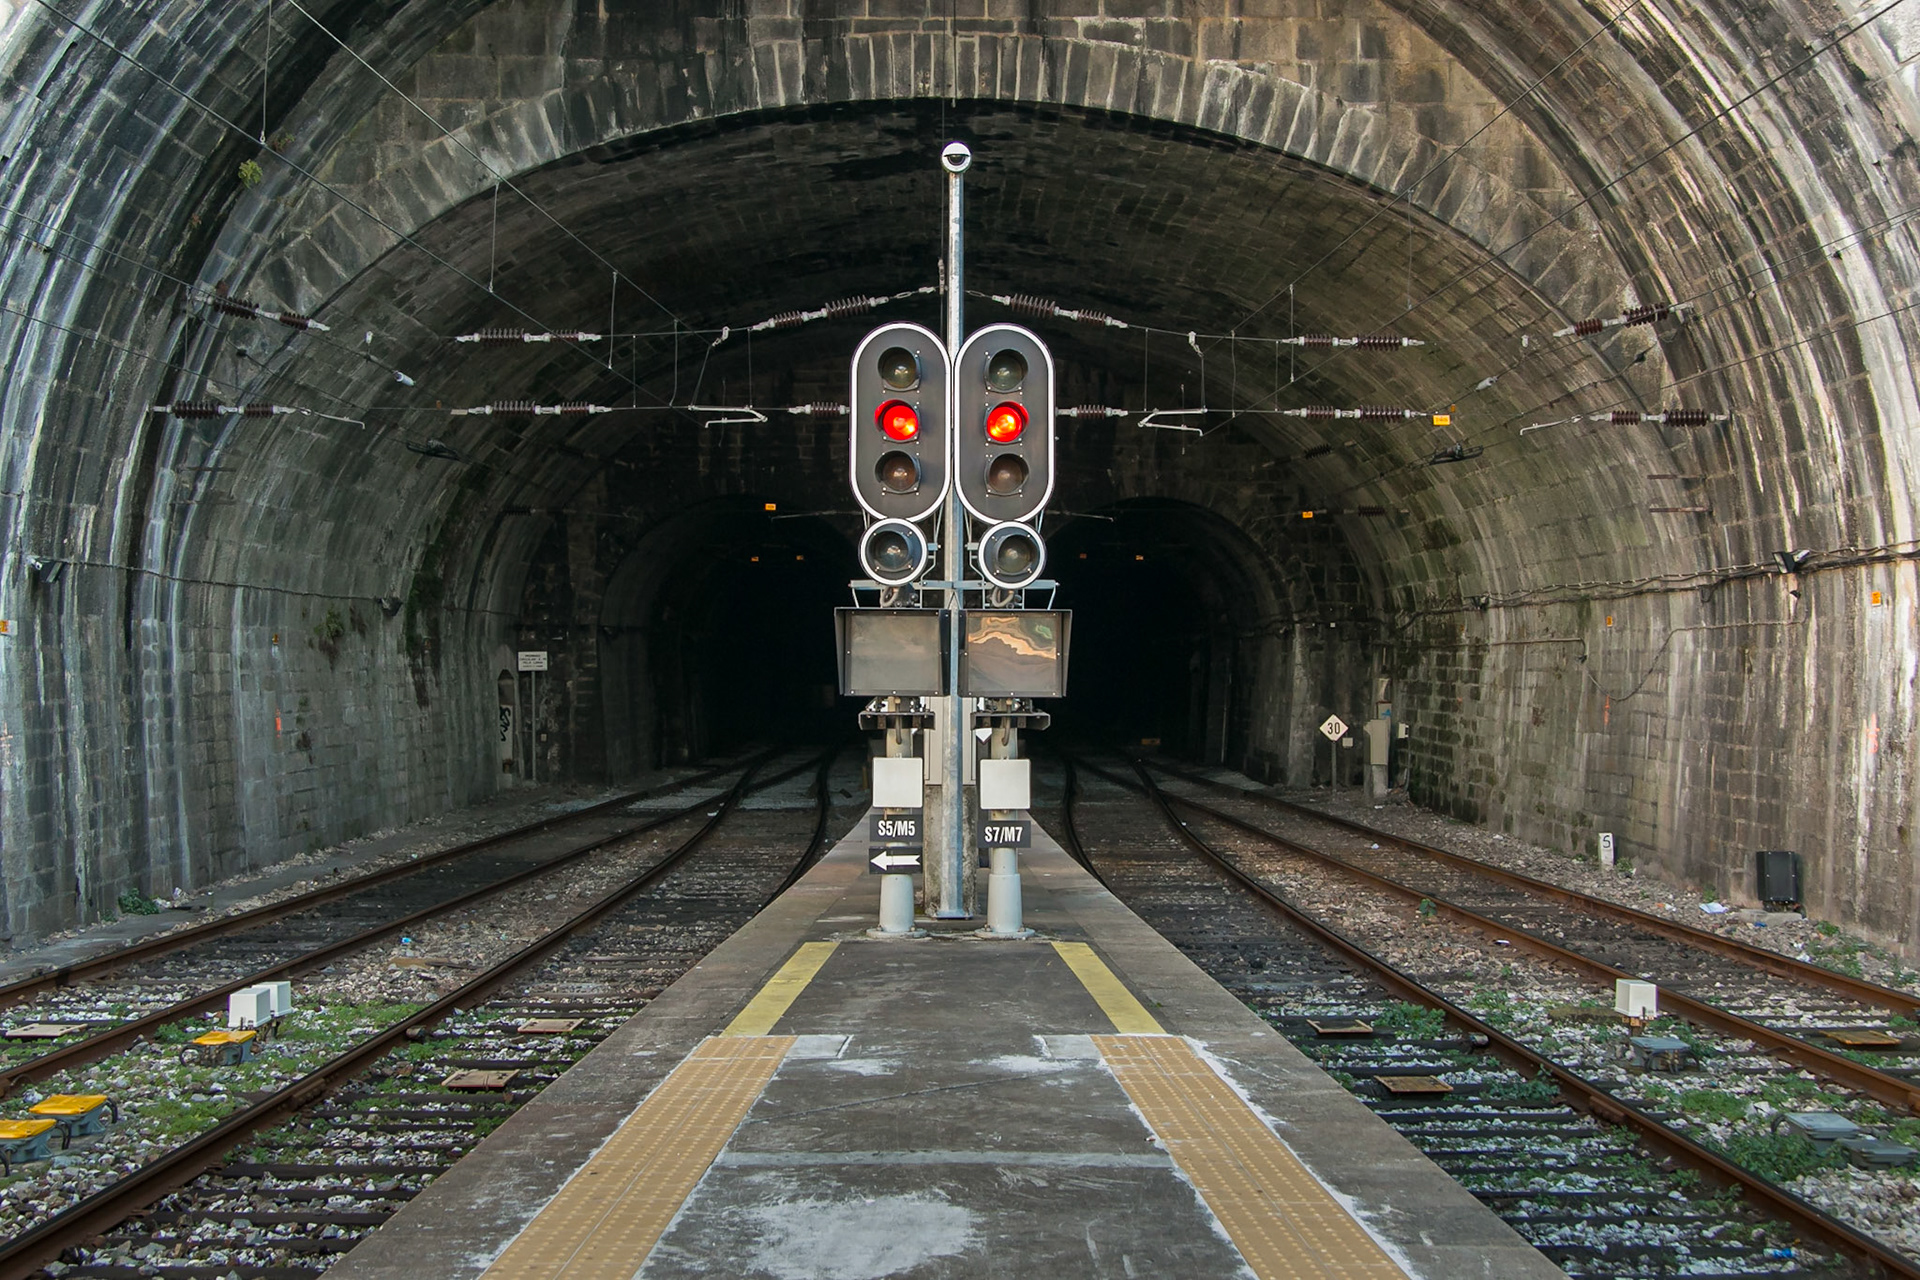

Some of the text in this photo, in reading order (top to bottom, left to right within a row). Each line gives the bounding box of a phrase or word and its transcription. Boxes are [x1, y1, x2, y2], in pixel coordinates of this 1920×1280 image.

[1327, 722, 1340, 735] 30
[878, 820, 916, 837] S5/M5
[984, 826, 1023, 843] S7/M7
